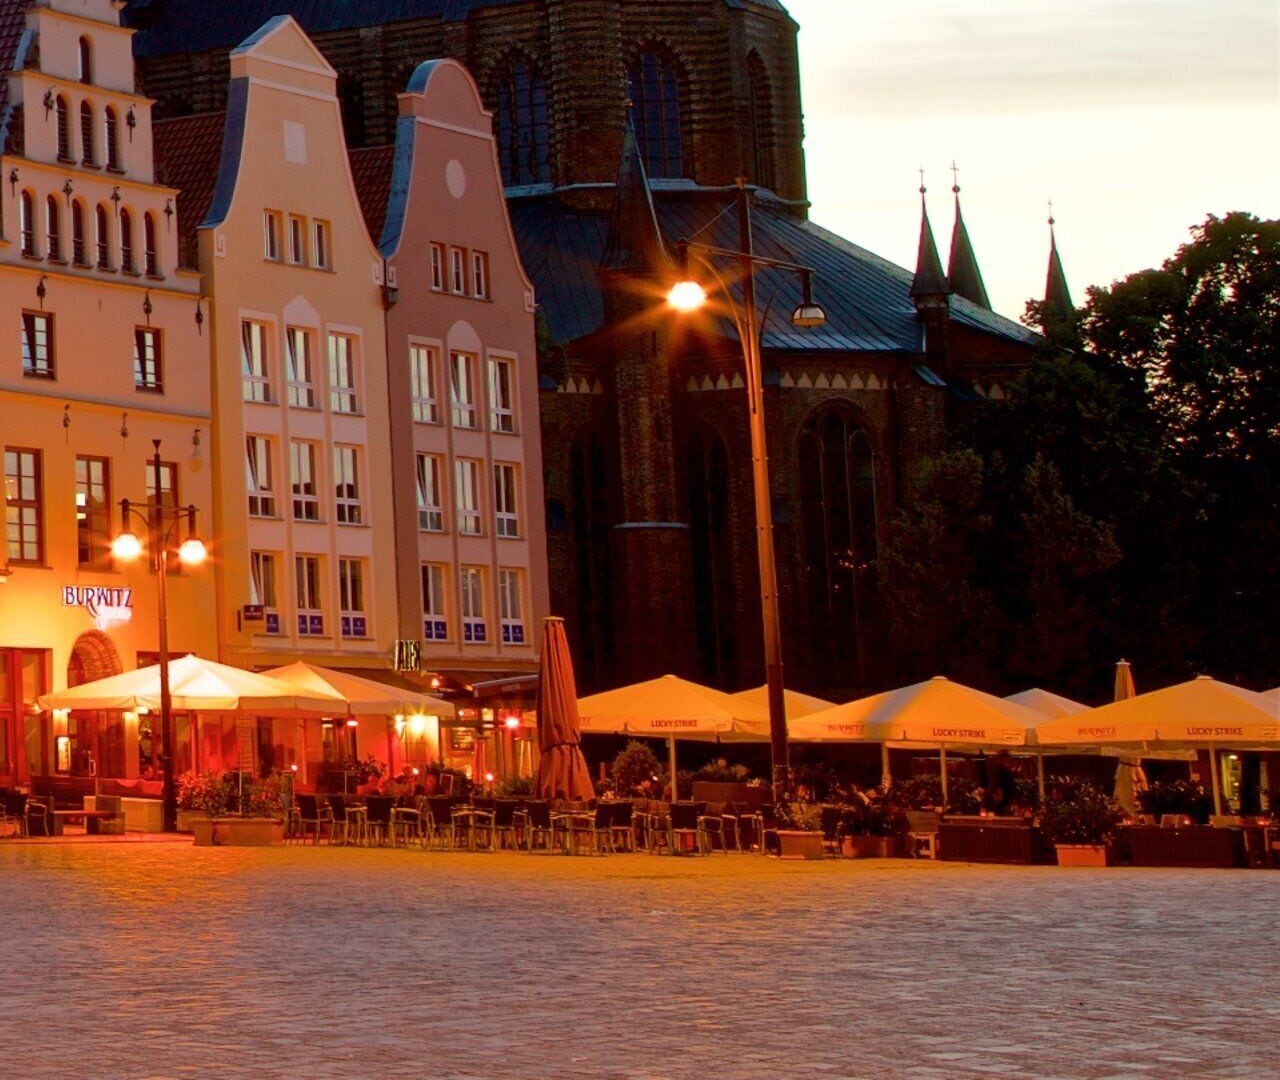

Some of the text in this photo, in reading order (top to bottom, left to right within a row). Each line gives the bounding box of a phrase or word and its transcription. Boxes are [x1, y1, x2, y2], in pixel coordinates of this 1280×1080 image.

[64, 586, 134, 619] BURWITZ
[651, 720, 698, 728] LUCKY STRIKE
[932, 728, 986, 738] LUCKY STRIKE
[1186, 727, 1243, 736] LUCKY STRIKE
